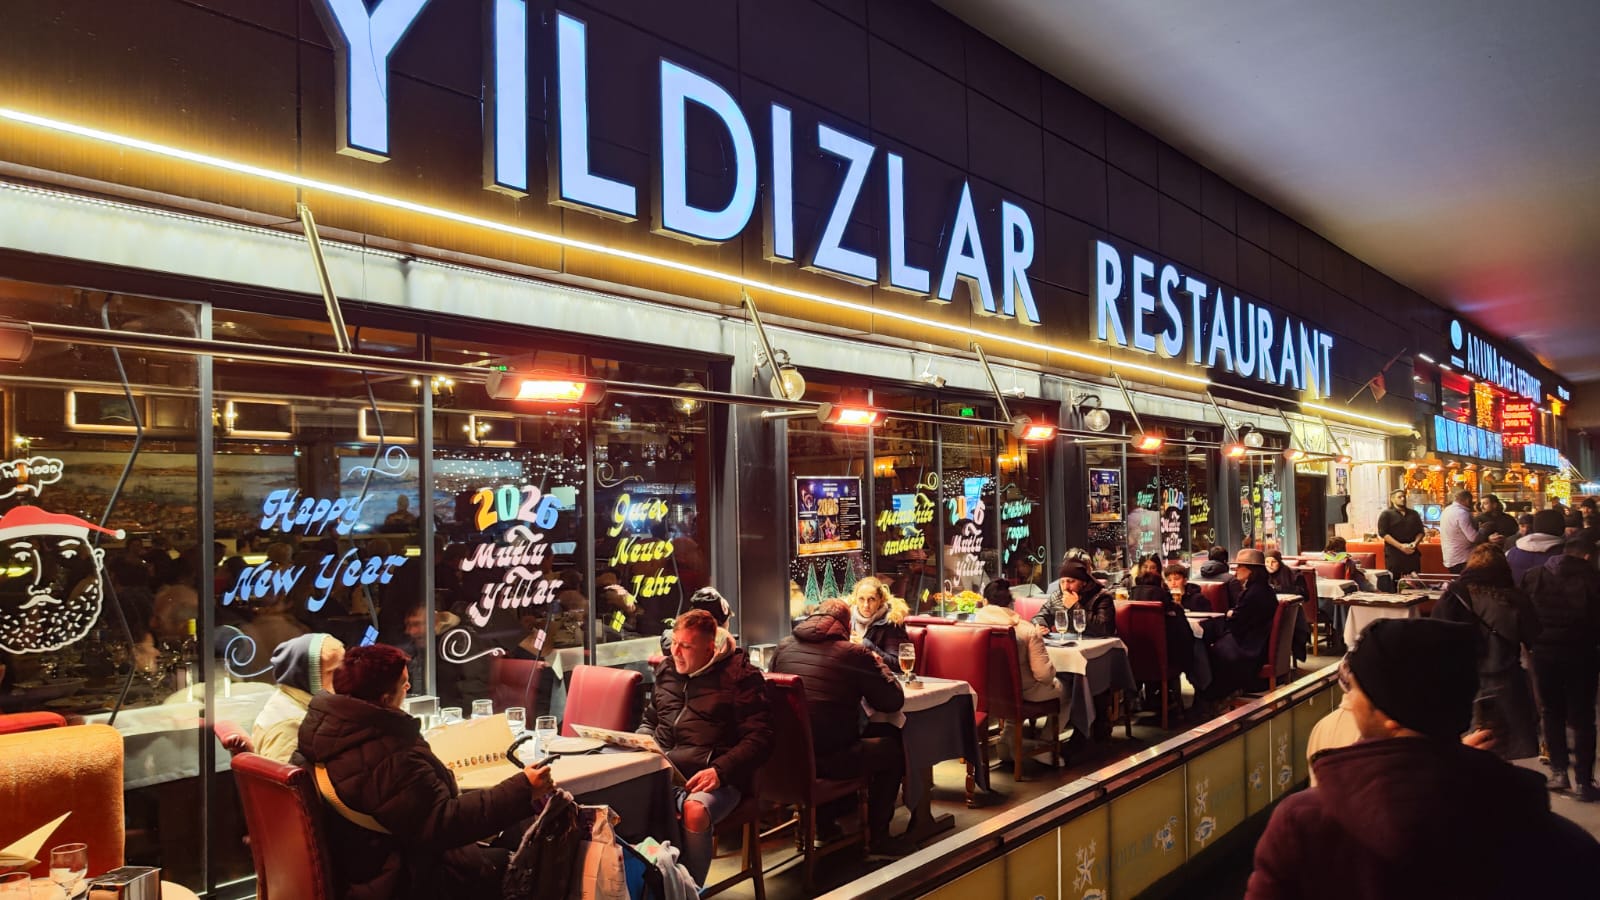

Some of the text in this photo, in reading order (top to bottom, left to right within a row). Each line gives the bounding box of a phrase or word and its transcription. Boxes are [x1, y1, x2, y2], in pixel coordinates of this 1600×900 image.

[314, 0, 1334, 400] YILDIZLAR RESTAURANT
[260, 488, 374, 535] Happy
[472, 484, 563, 531] 2026
[947, 495, 986, 526] 2026
[1162, 487, 1185, 511] 2026
[460, 525, 548, 572] Mutlu
[609, 537, 674, 568] Neues
[223, 548, 409, 612] New Year
[626, 567, 679, 606] Jahr
